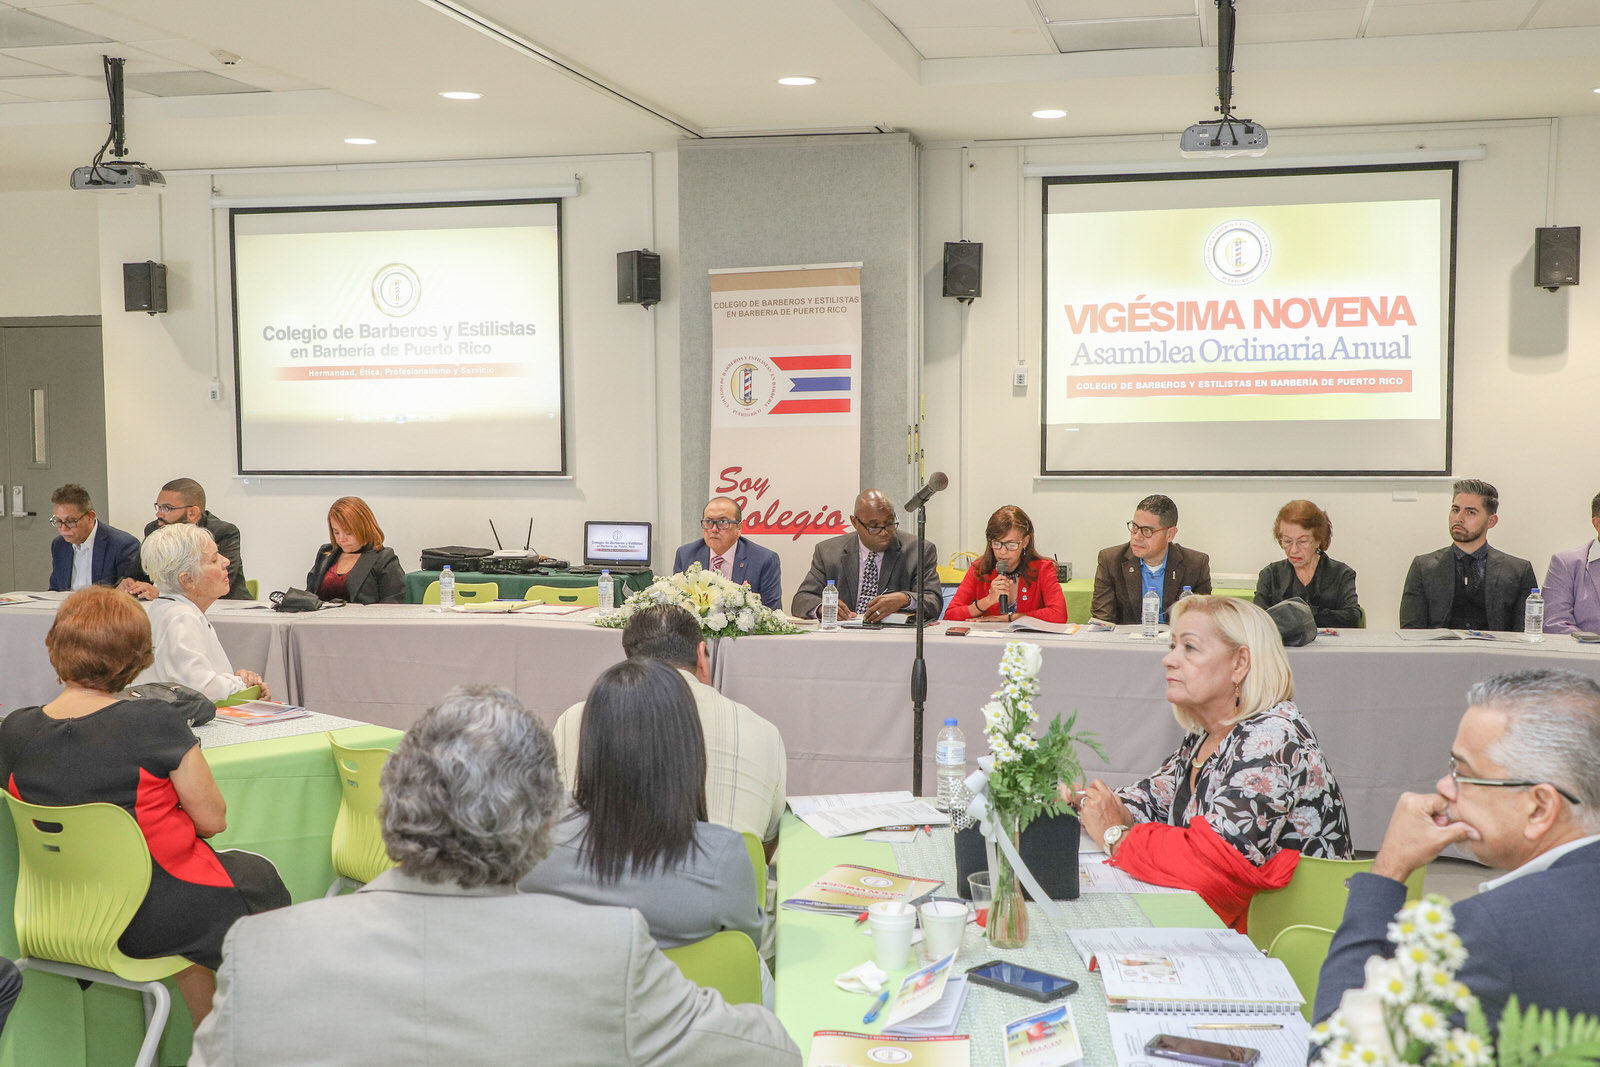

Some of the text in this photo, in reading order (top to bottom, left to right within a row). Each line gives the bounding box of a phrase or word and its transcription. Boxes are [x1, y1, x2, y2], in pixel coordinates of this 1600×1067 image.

[713, 296, 860, 310] COLEGIO DE BARBEROS Y ESTILISTAS
[726, 306, 848, 318] EN BARBERIA DE PUERTO RICO
[1064, 294, 1418, 334] VIGÉSIMA NOVENA
[262, 321, 537, 344] Colegio de Barberos y Estilistas
[290, 341, 492, 358] en Barbería de Puerto Rico
[1070, 334, 1412, 366] Asamblea Ordinaria Anual
[308, 369, 357, 377] Hermandad,
[385, 367, 451, 375] Profesionalismo
[460, 366, 495, 374] Servicio
[1076, 377, 1404, 391] COLEGIO DE BARBEROS Y ESTILISTAS EN BARBERÍA DE PUERTO RICO
[715, 466, 770, 500] Soy
